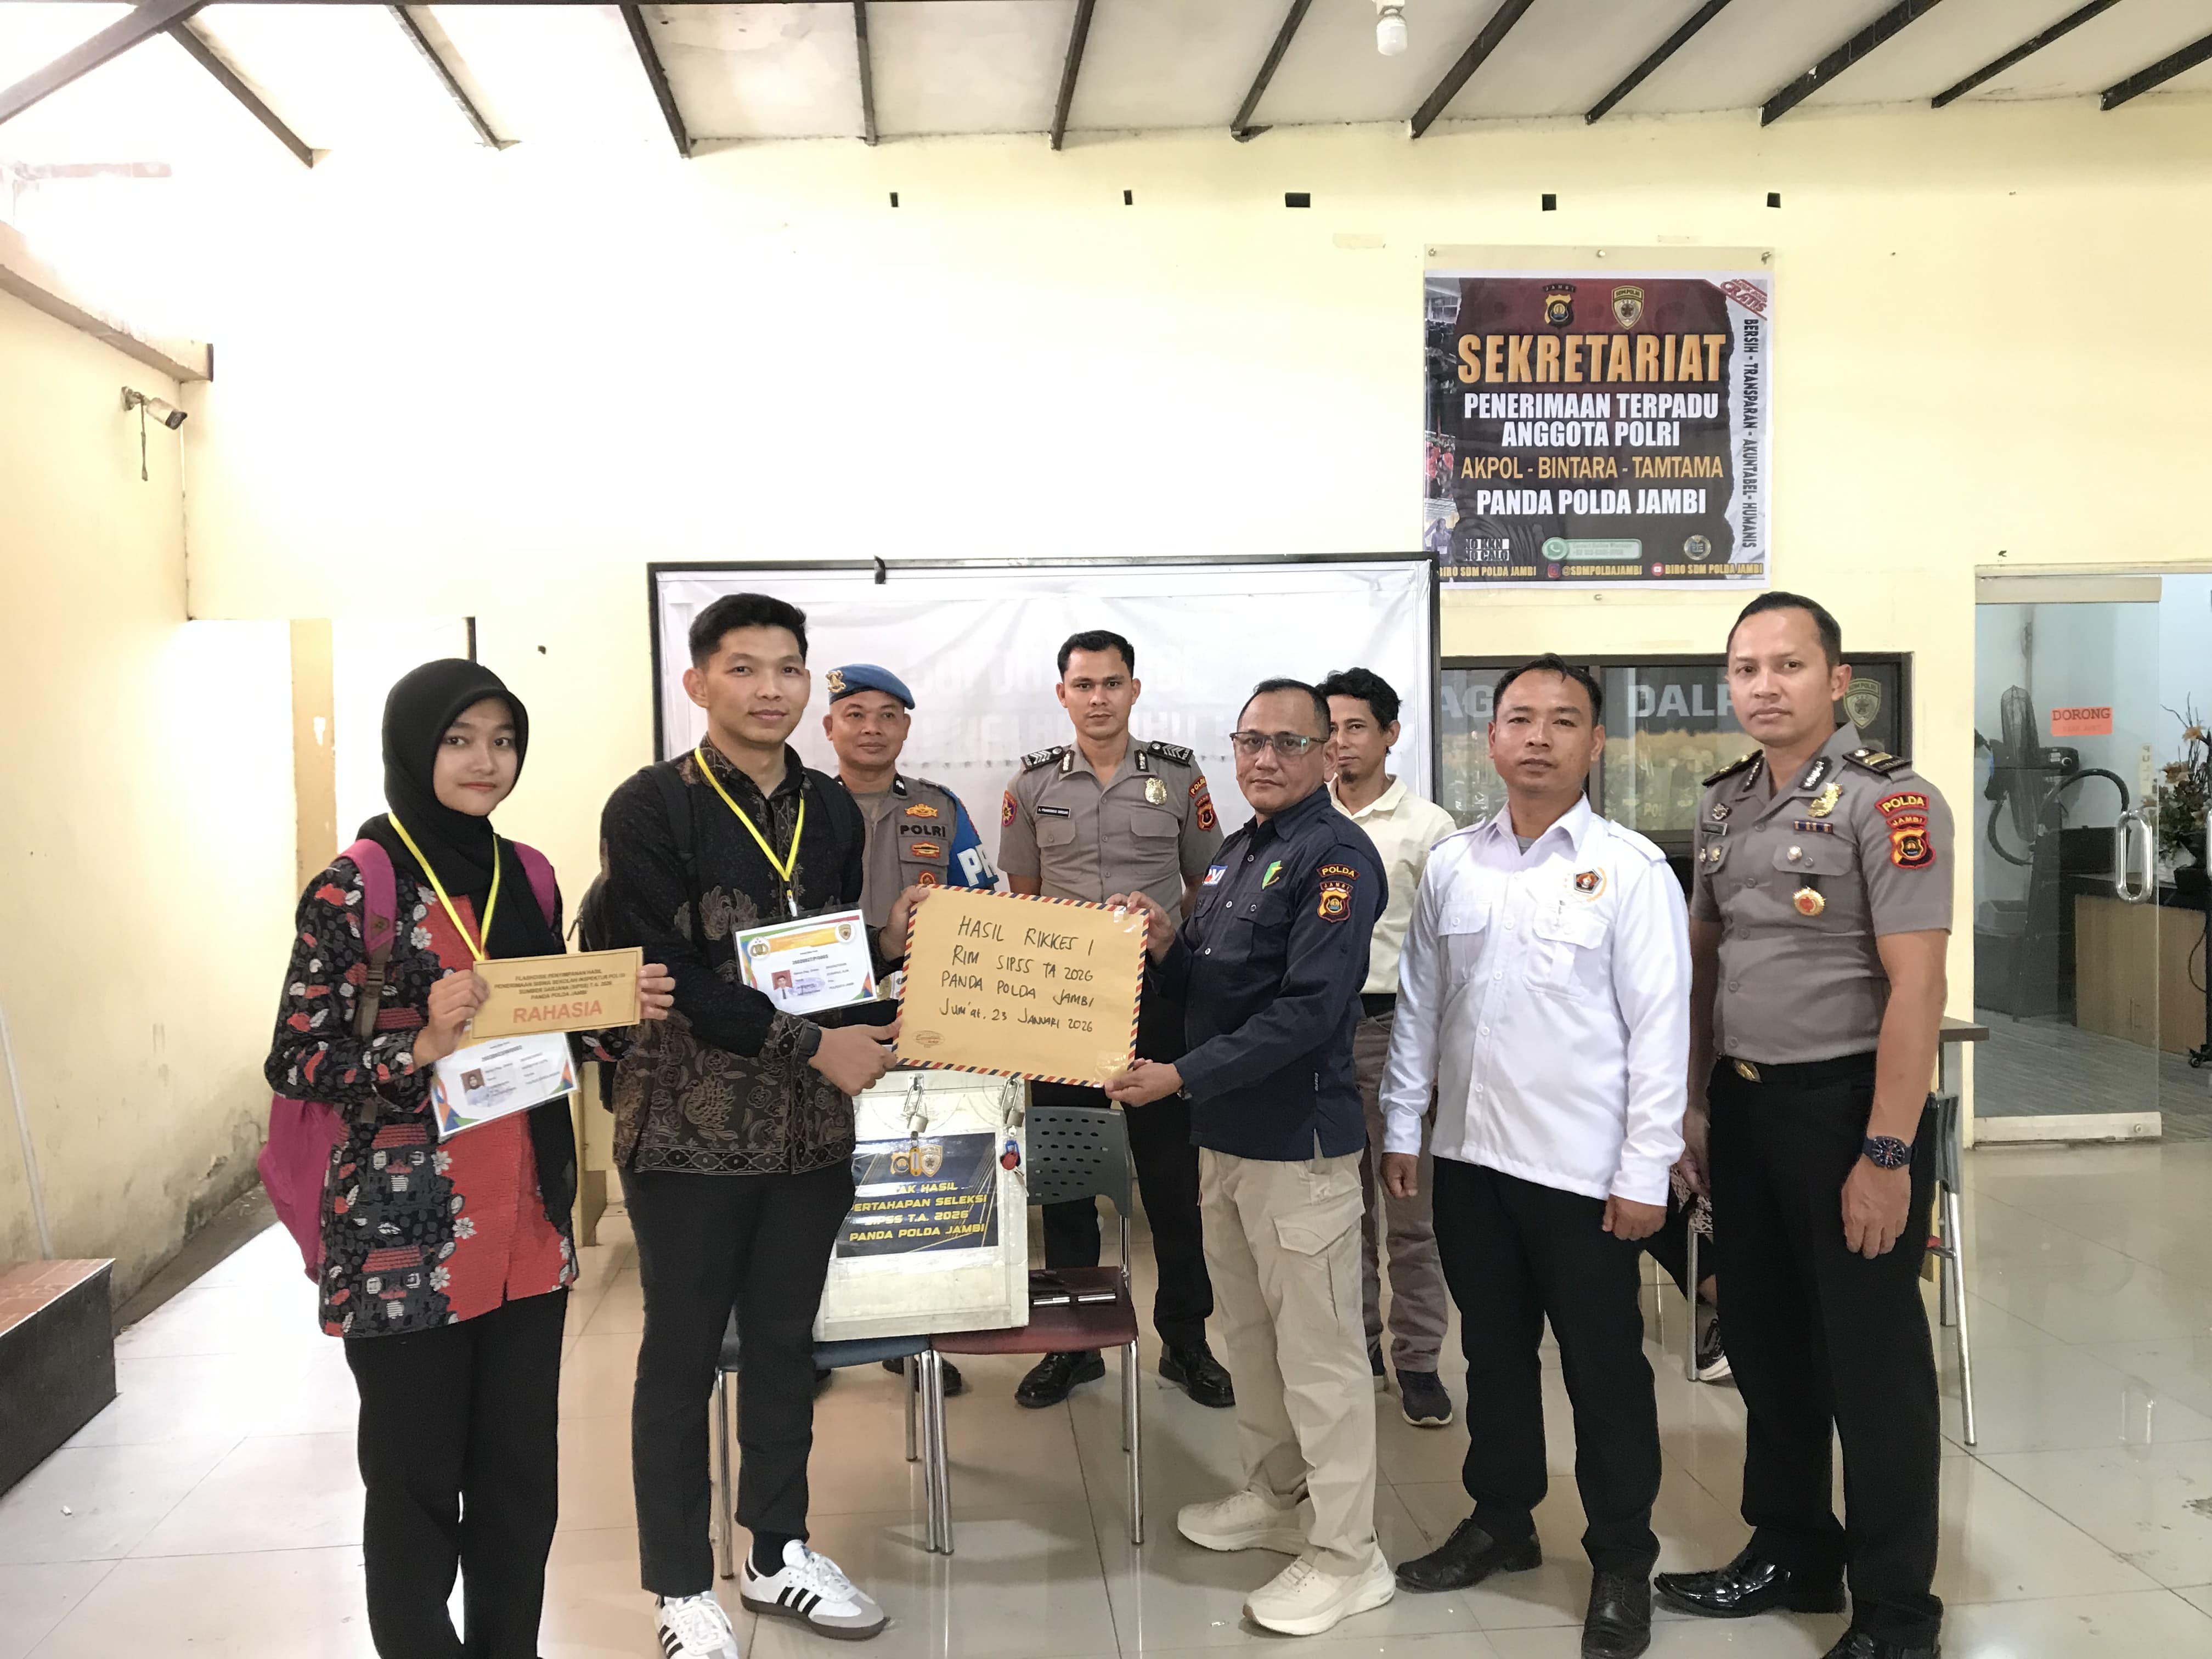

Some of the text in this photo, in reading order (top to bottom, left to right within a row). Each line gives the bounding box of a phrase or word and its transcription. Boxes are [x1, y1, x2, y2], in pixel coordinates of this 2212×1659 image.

[1744, 319, 1759, 352] BERSIH
[1458, 334, 1726, 383] SEKRETARIAT
[1743, 363, 1758, 428] TRANSPARAN
[1464, 393, 1719, 419] PENERIMAAN TERPADU
[1502, 421, 1680, 447] ANGGOTA POLRI
[1461, 456, 1523, 479] AKPOL
[1538, 456, 1618, 478] BINTARA
[1633, 456, 1723, 478] TAMTAMA
[1477, 489, 1706, 515] PANDA POLDA JAMBI
[1742, 503, 1757, 548] HUMANIS
[1464, 539, 1503, 549] NO KKN
[1464, 550, 1508, 561] NO CALO
[1460, 566, 1479, 576] SDM
[1482, 566, 1509, 576] POLDA
[1510, 566, 1536, 576] JAMBI
[1562, 565, 1642, 575] @SDMPOLDAJAMBI
[1665, 563, 1763, 574] BIRO SDM POLDA JAMBI
[2052, 708, 2111, 720] DORONG
[1882, 796, 1925, 812] POLDA
[1893, 816, 1923, 826] JAMBI
[900, 825, 946, 837] POLRI
[1322, 867, 1355, 877] POLDA
[957, 915, 1005, 941] HASIL
[1024, 928, 1079, 950] RIKKES
[952, 945, 980, 966] RIM
[1043, 962, 1056, 978] TA
[1064, 967, 1093, 981] 2026
[941, 970, 1094, 1007] PANDA POLDA JAMBI
[513, 1000, 602, 1024] RAHASIA
[992, 1008, 1007, 1021] 23
[1068, 1018, 1093, 1032] 2026
[921, 1182, 958, 1192] HASIL
[851, 1194, 987, 1212] ERTAHAPAN SELEKSI
[908, 1214, 929, 1223] T.A.
[934, 1210, 969, 1221] 2026
[849, 1223, 985, 1242] PANDA POLDA JAMBI
